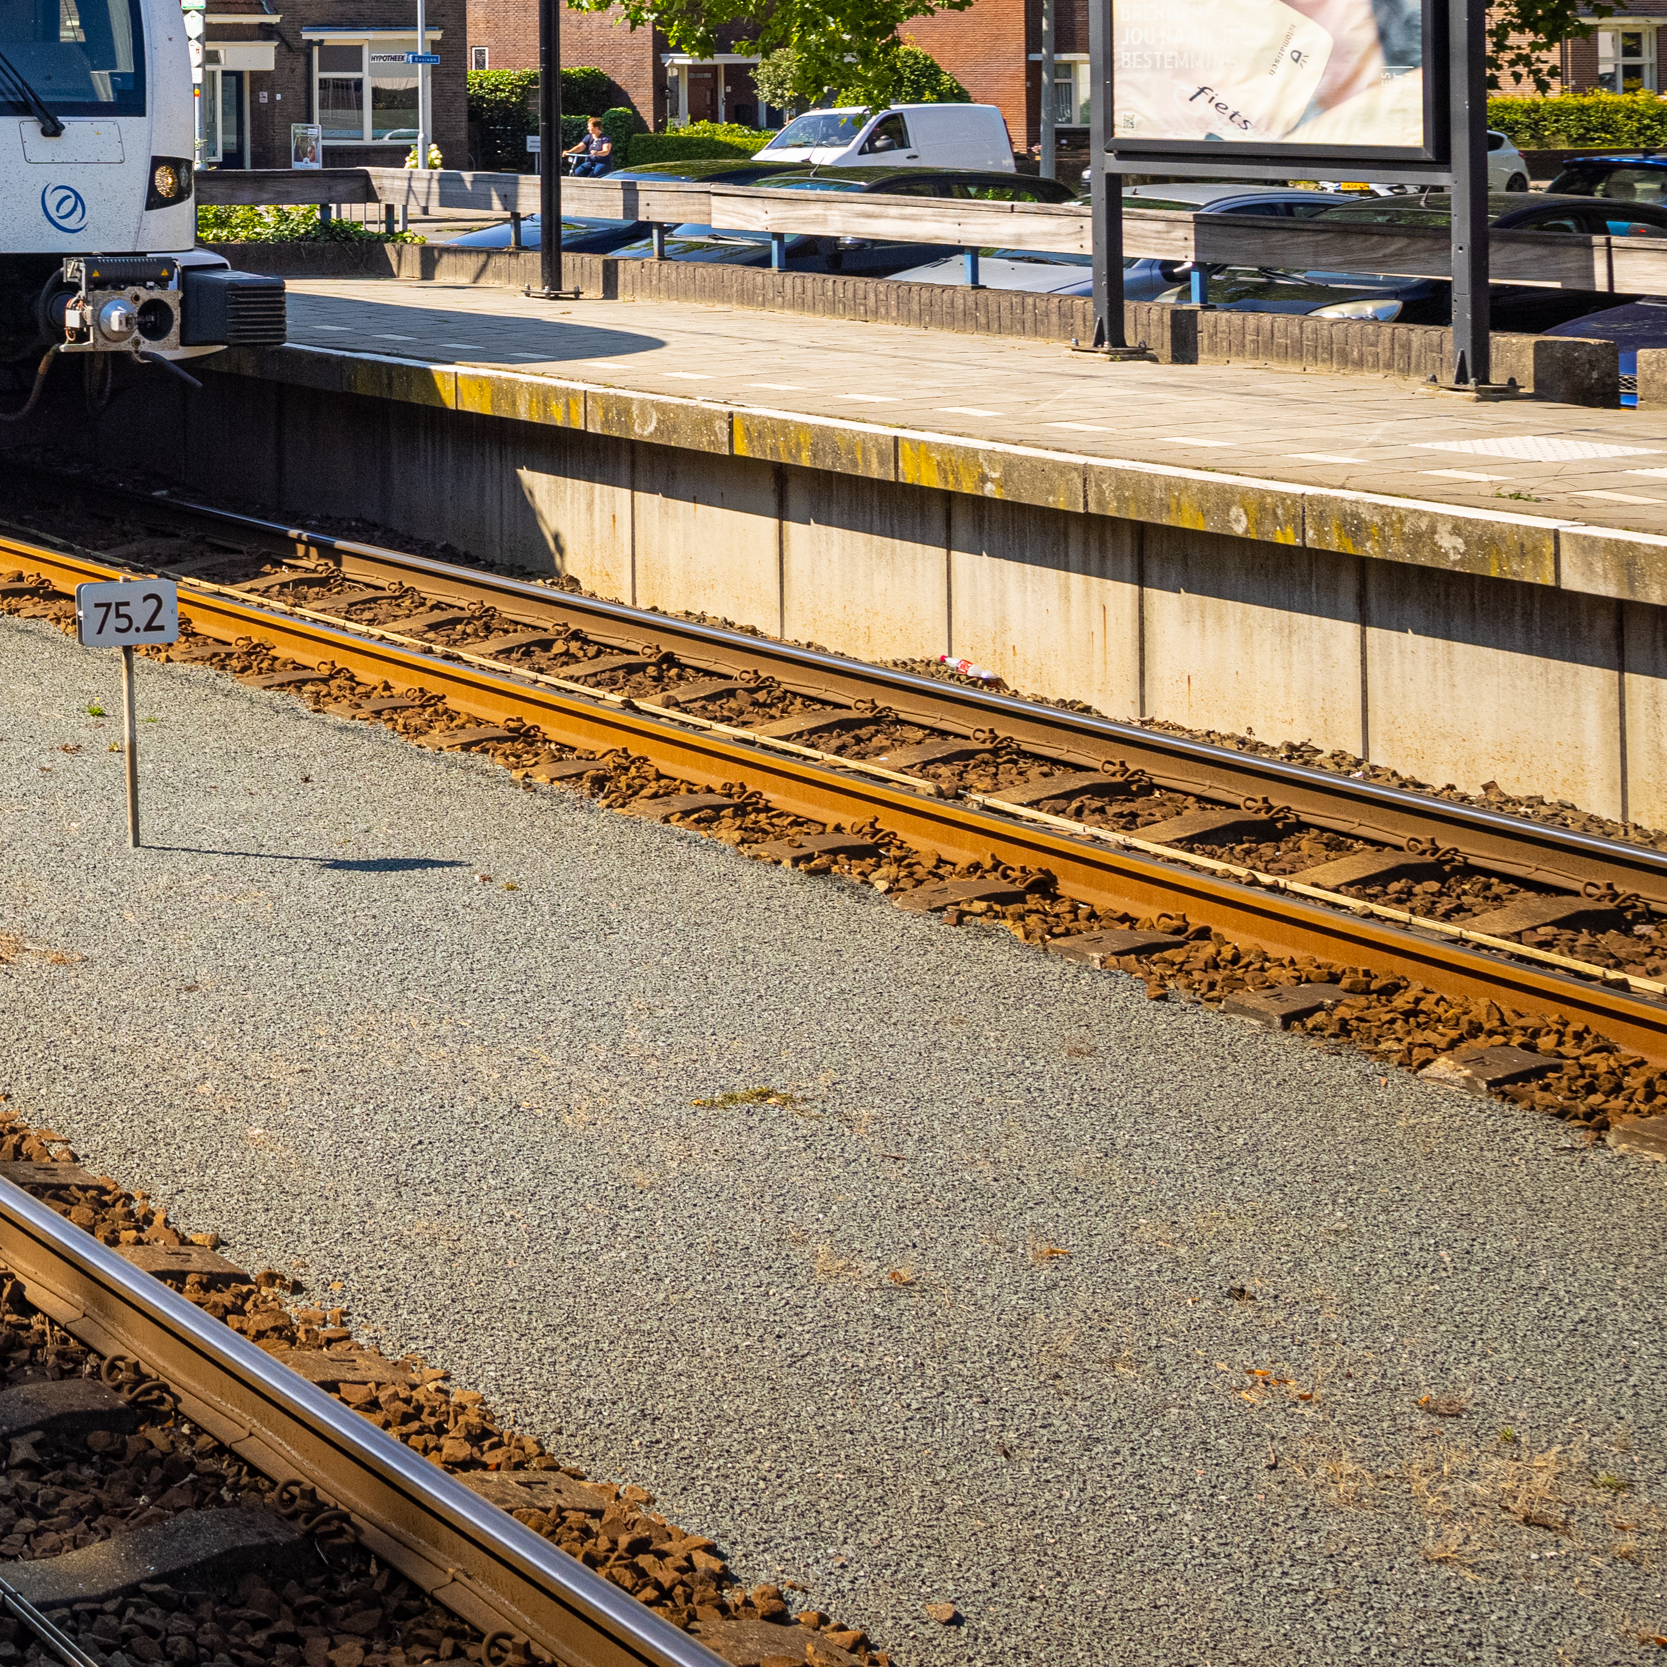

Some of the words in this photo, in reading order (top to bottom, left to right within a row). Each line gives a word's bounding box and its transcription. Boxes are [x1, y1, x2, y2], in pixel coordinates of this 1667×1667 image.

[1120, 28, 1155, 46] JOU
[370, 54, 406, 62] HYPOTHEEK
[1188, 85, 1254, 133] fiets
[93, 593, 166, 635] 75.2
